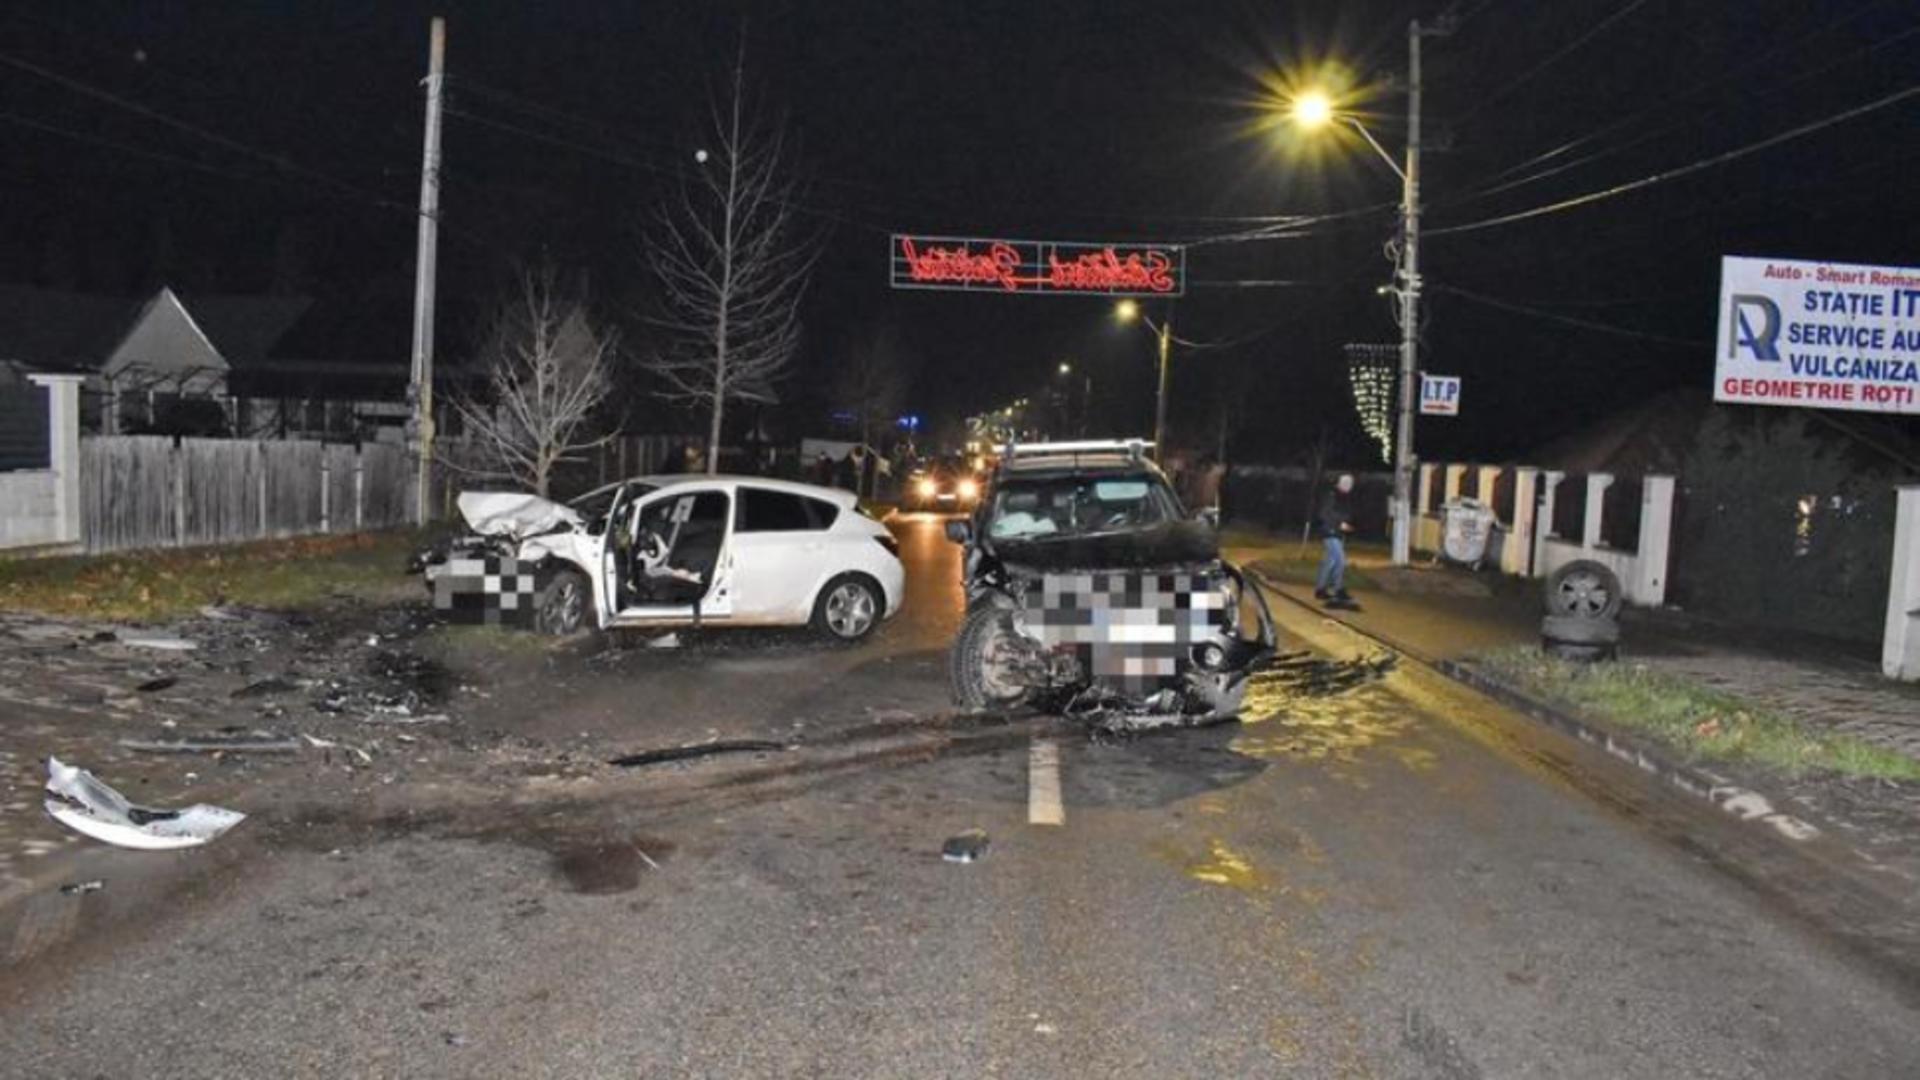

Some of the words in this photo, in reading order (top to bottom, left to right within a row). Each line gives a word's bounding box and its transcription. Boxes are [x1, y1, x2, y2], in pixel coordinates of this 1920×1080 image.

[1764, 264, 1802, 280] Auto
[1816, 266, 1865, 285] Smart
[1788, 321, 1884, 349] SERVICE
[1891, 328, 1920, 351] AU
[1789, 353, 1918, 382] VULCANIZA
[1723, 378, 1854, 401] GEOMETRIE
